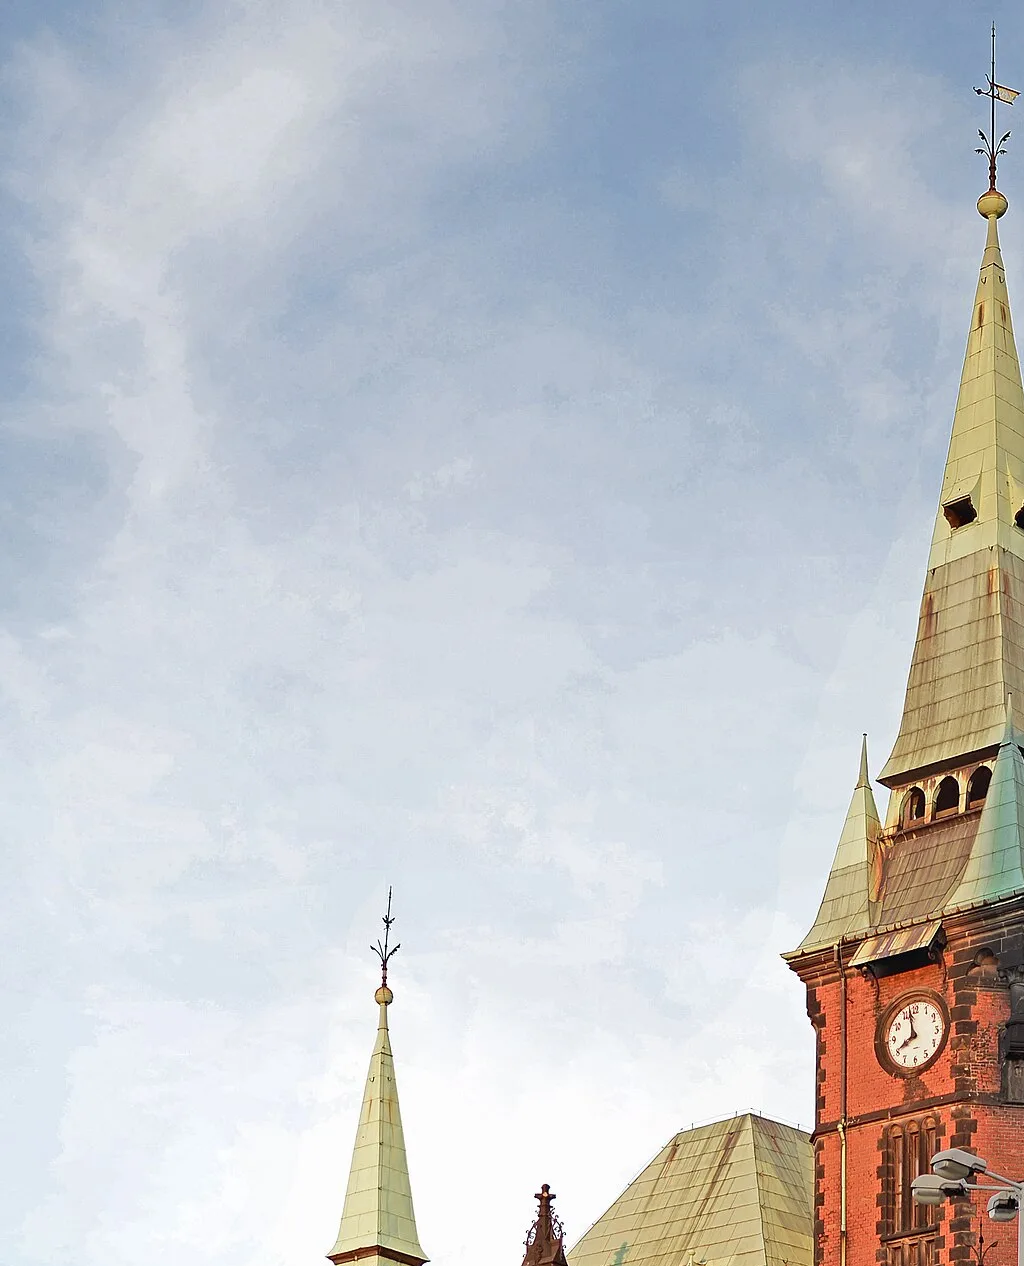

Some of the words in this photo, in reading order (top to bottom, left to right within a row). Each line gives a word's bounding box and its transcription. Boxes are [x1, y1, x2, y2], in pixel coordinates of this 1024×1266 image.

[912, 1005, 919, 1014] 12
[924, 1005, 928, 1015] 1
[931, 1012, 936, 1023] 2
[893, 1022, 901, 1031] 10
[891, 1035, 896, 1044] 9
[903, 1055, 907, 1063] 7
[923, 1050, 929, 1059] 5
[913, 1056, 918, 1065] 6
